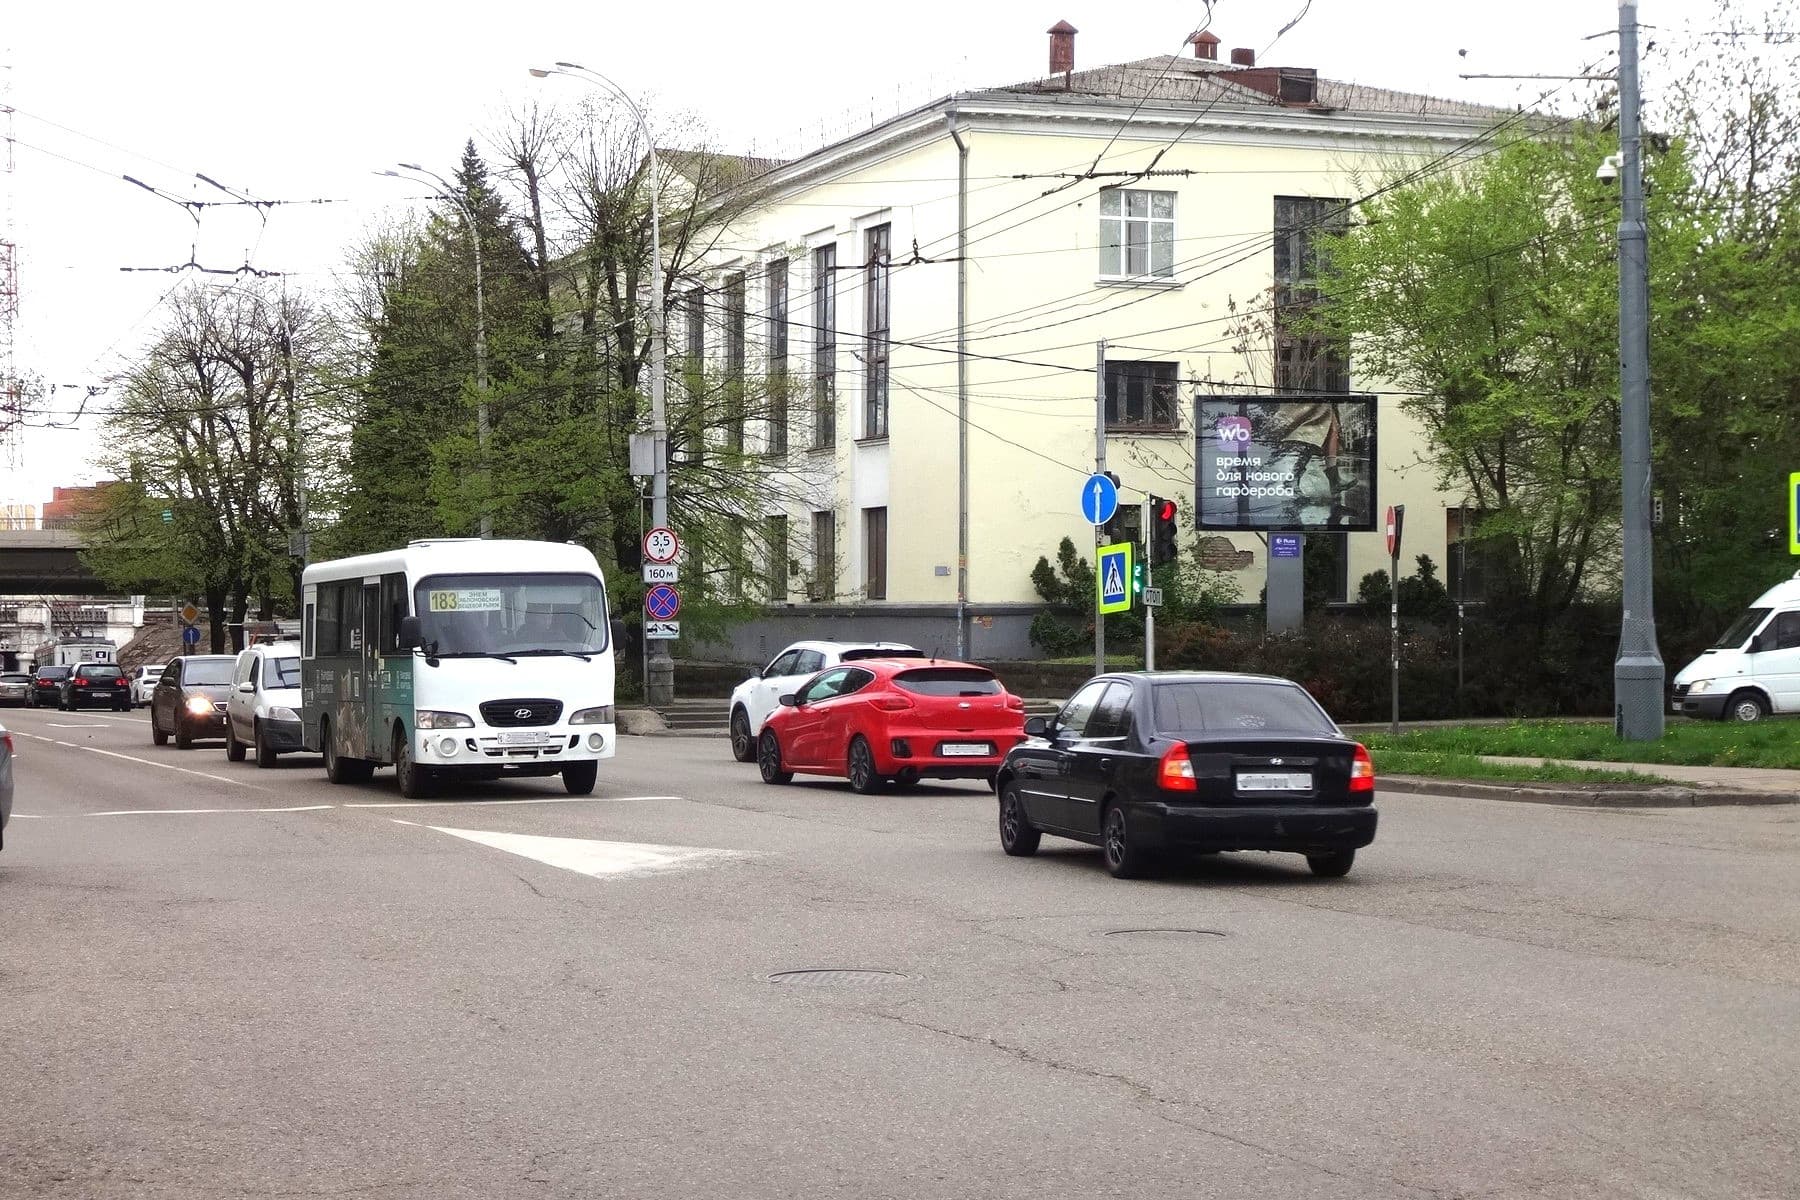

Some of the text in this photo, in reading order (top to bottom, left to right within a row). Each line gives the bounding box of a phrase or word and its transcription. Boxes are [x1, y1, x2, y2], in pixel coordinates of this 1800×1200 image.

[1219, 424, 1249, 441] wb
[1216, 457, 1261, 469] время
[1216, 469, 1294, 482] для нового
[1216, 484, 1294, 499] гардероба
[653, 536, 670, 546] 3,5
[432, 592, 457, 609] 183
[1146, 589, 1161, 604] СТОП
